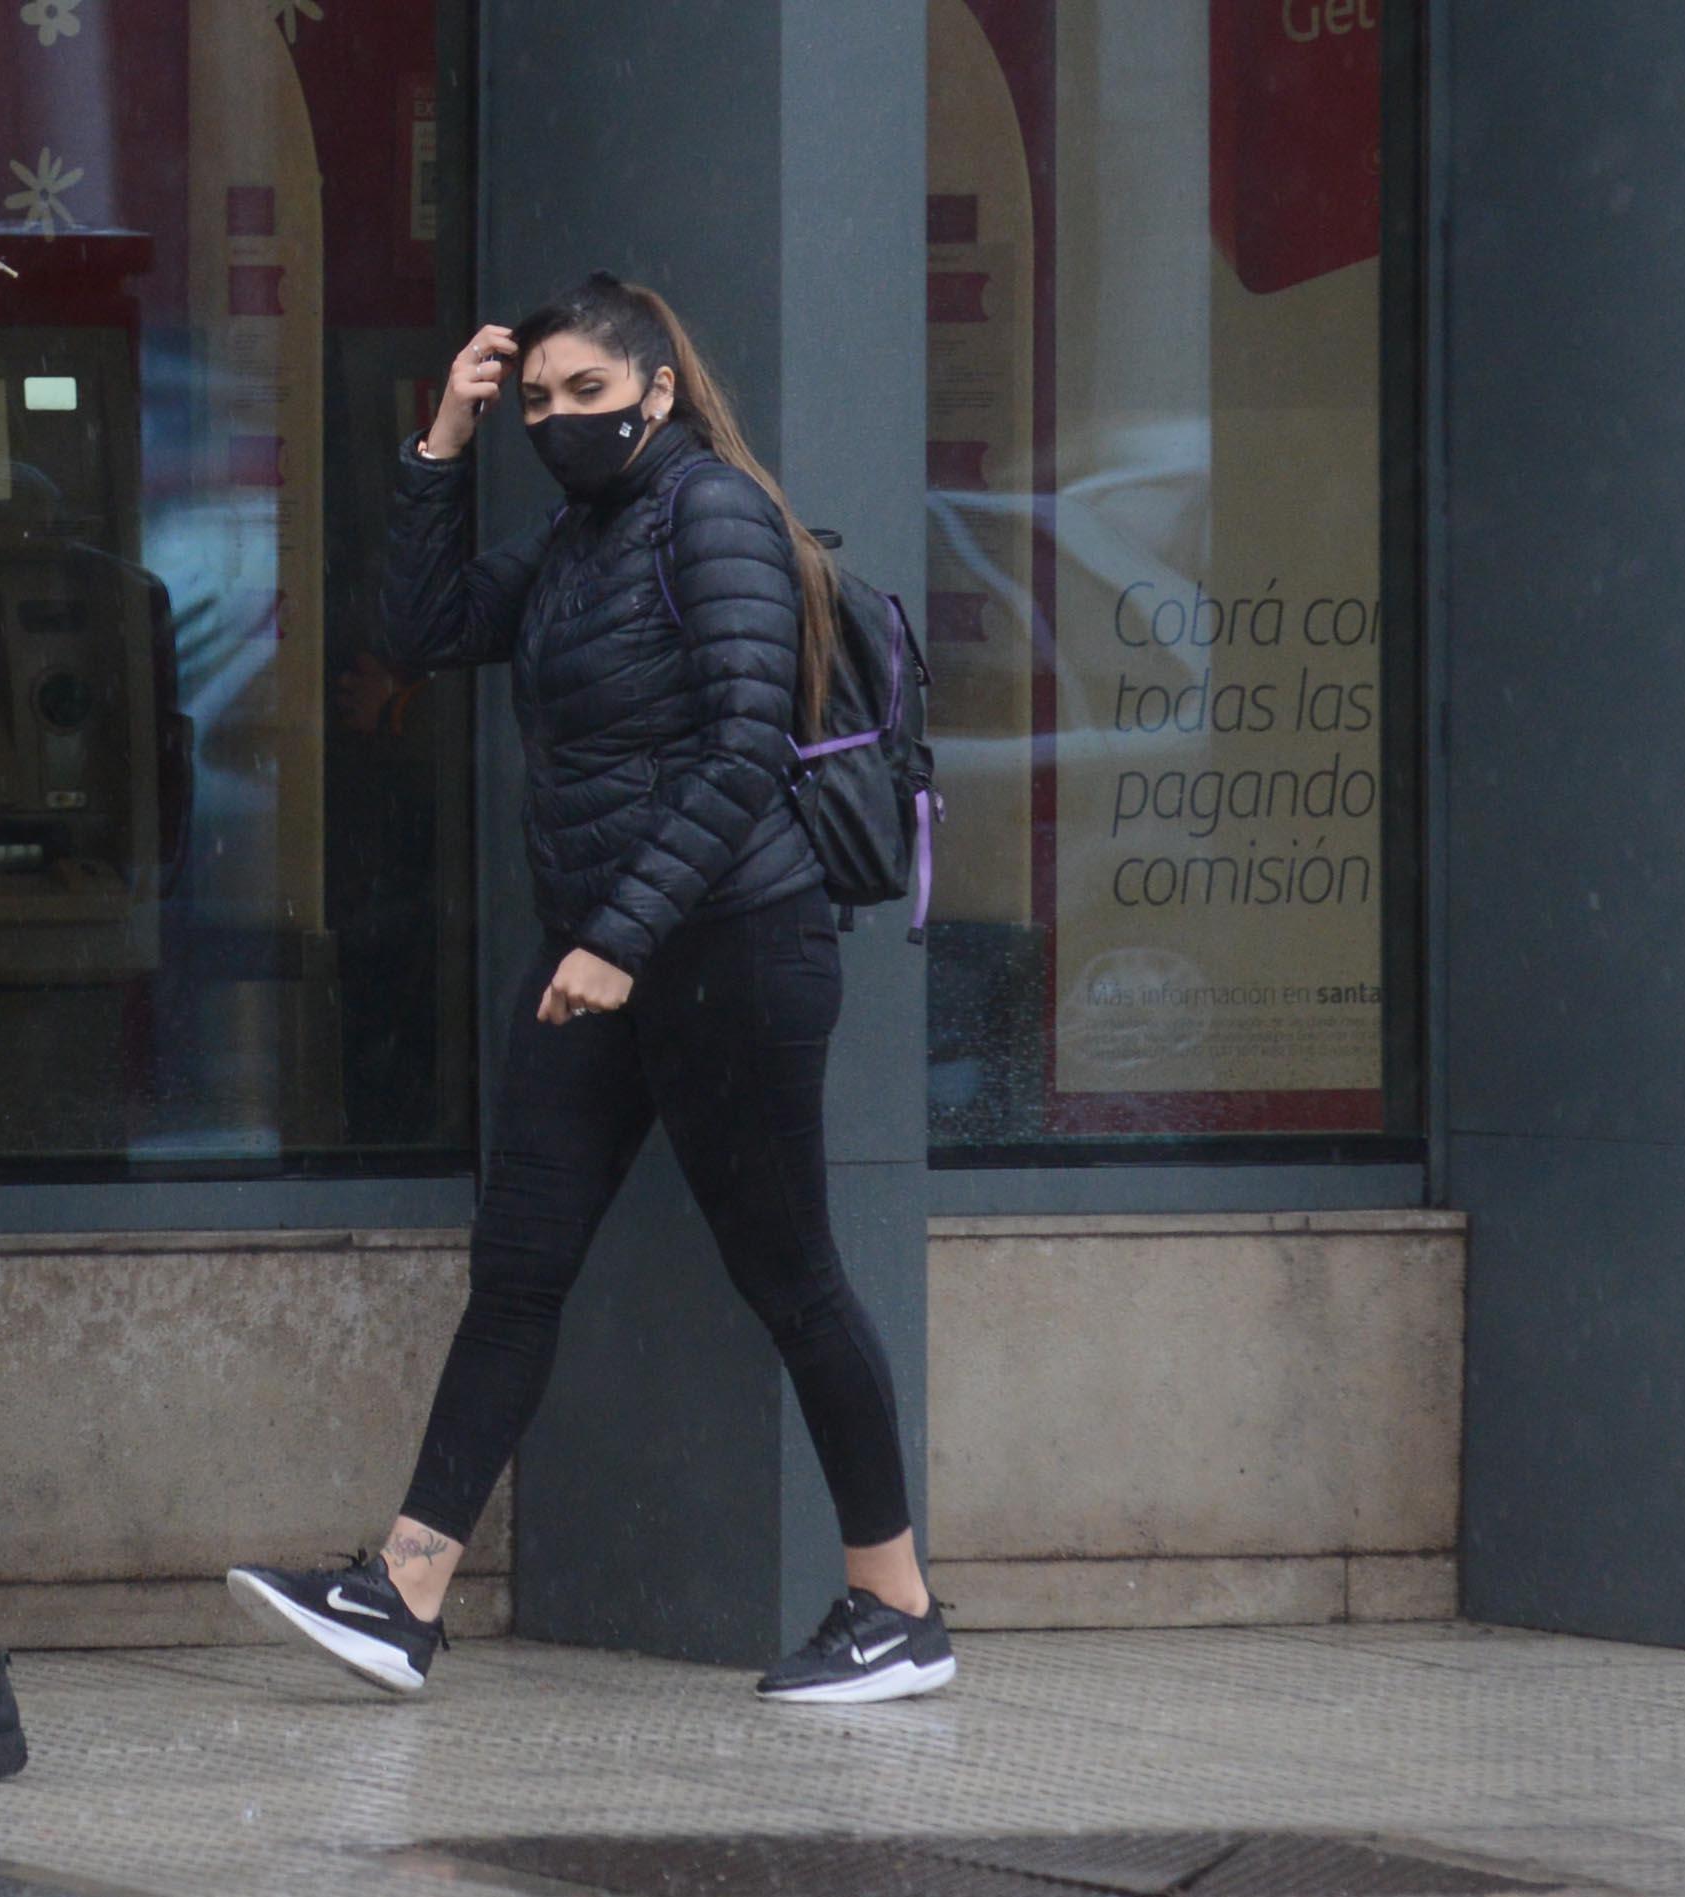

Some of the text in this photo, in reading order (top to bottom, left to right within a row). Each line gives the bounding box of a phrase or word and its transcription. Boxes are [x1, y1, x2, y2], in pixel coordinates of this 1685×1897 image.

[1114, 577, 1380, 647] Cobrá co
[1114, 666, 1374, 733] todas las
[1111, 751, 1376, 838] pagando
[1112, 835, 1371, 906] comisión
[1282, 986, 1311, 1004] en
